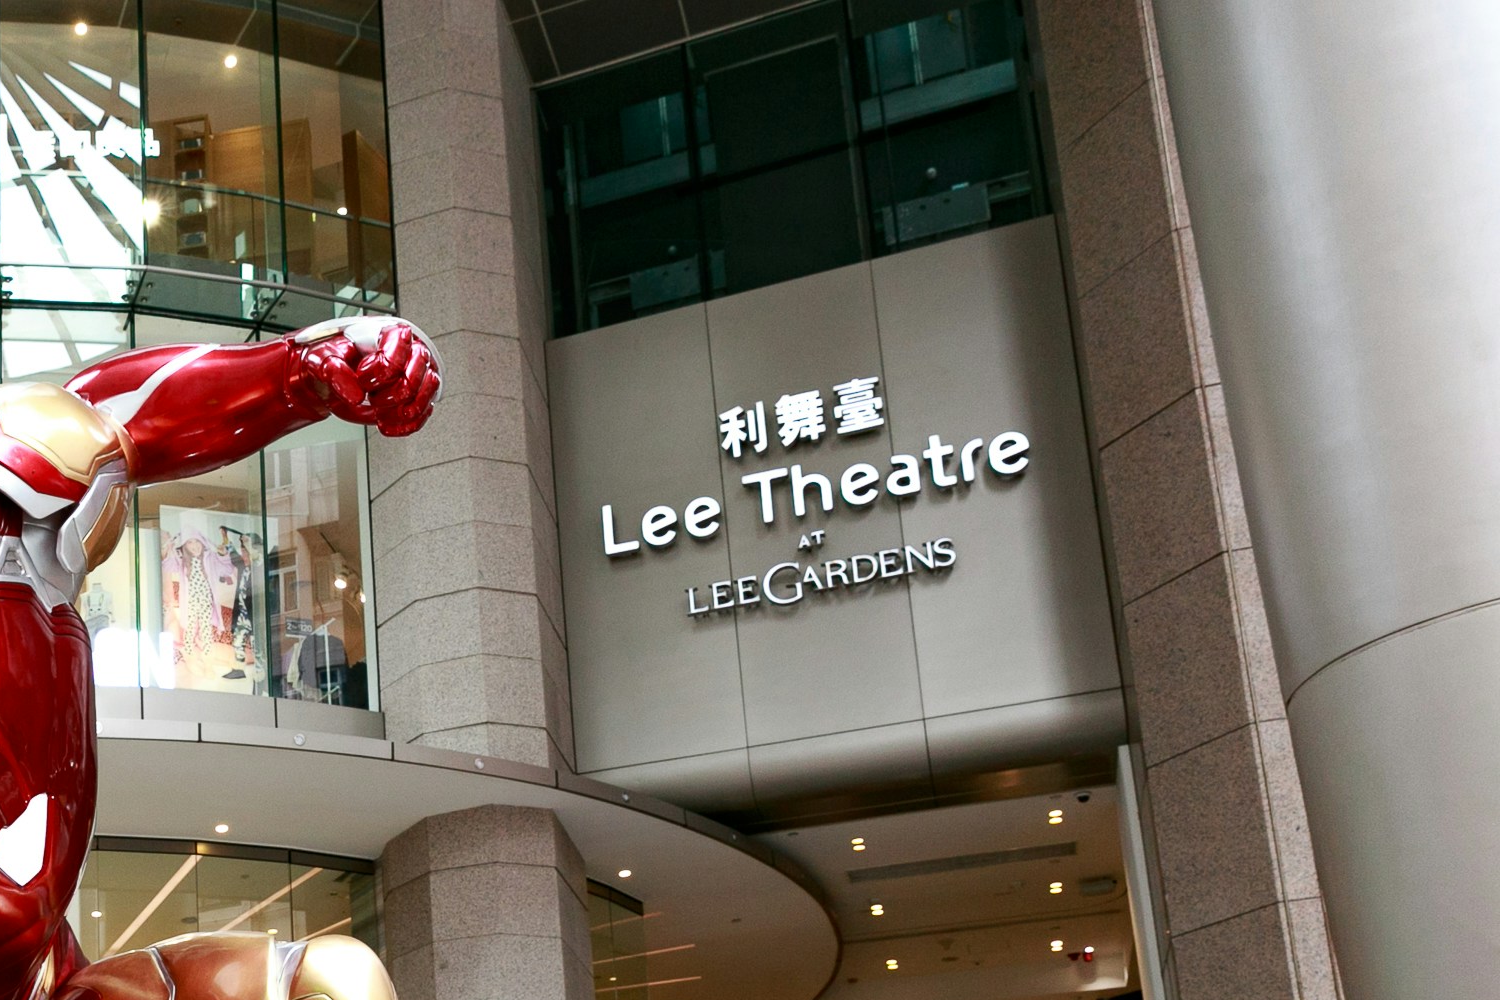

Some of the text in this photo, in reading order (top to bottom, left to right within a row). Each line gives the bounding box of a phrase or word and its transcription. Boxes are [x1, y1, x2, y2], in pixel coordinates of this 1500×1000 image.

[719, 376, 885, 458] 利舞臺
[601, 431, 1030, 557] Lee Theatre
[798, 529, 826, 550] AT
